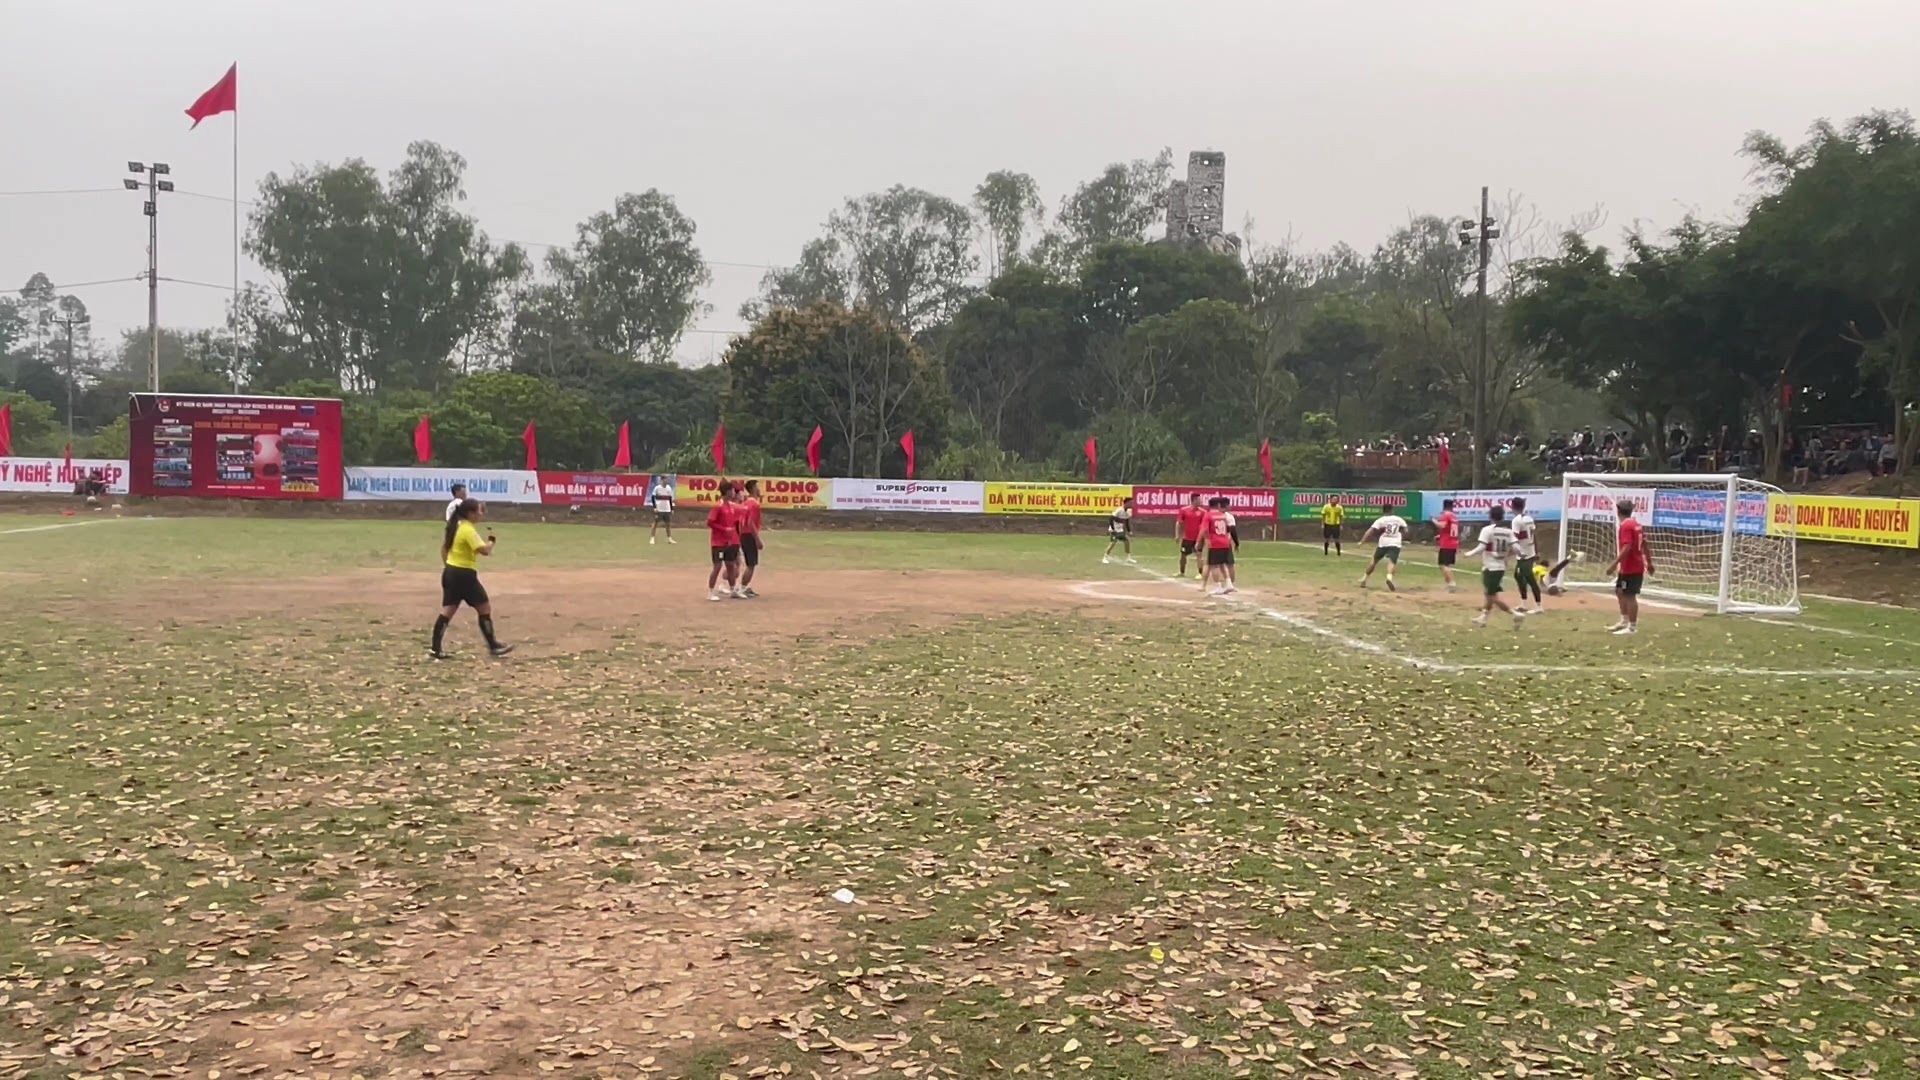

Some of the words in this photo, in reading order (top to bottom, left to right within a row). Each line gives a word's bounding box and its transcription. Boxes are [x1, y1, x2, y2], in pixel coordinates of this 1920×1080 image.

[14, 461, 52, 487] NGHỆ
[545, 483, 566, 494] MUA
[567, 482, 587, 495] BÁN
[765, 480, 818, 493] LONG
[767, 495, 789, 503] CAO
[792, 493, 814, 504] CẤP
[1027, 494, 1057, 508] NGHỆ
[1060, 494, 1090, 507] XUÂN
[1293, 492, 1323, 505] AUTO
[1828, 506, 1861, 529] TRANG
